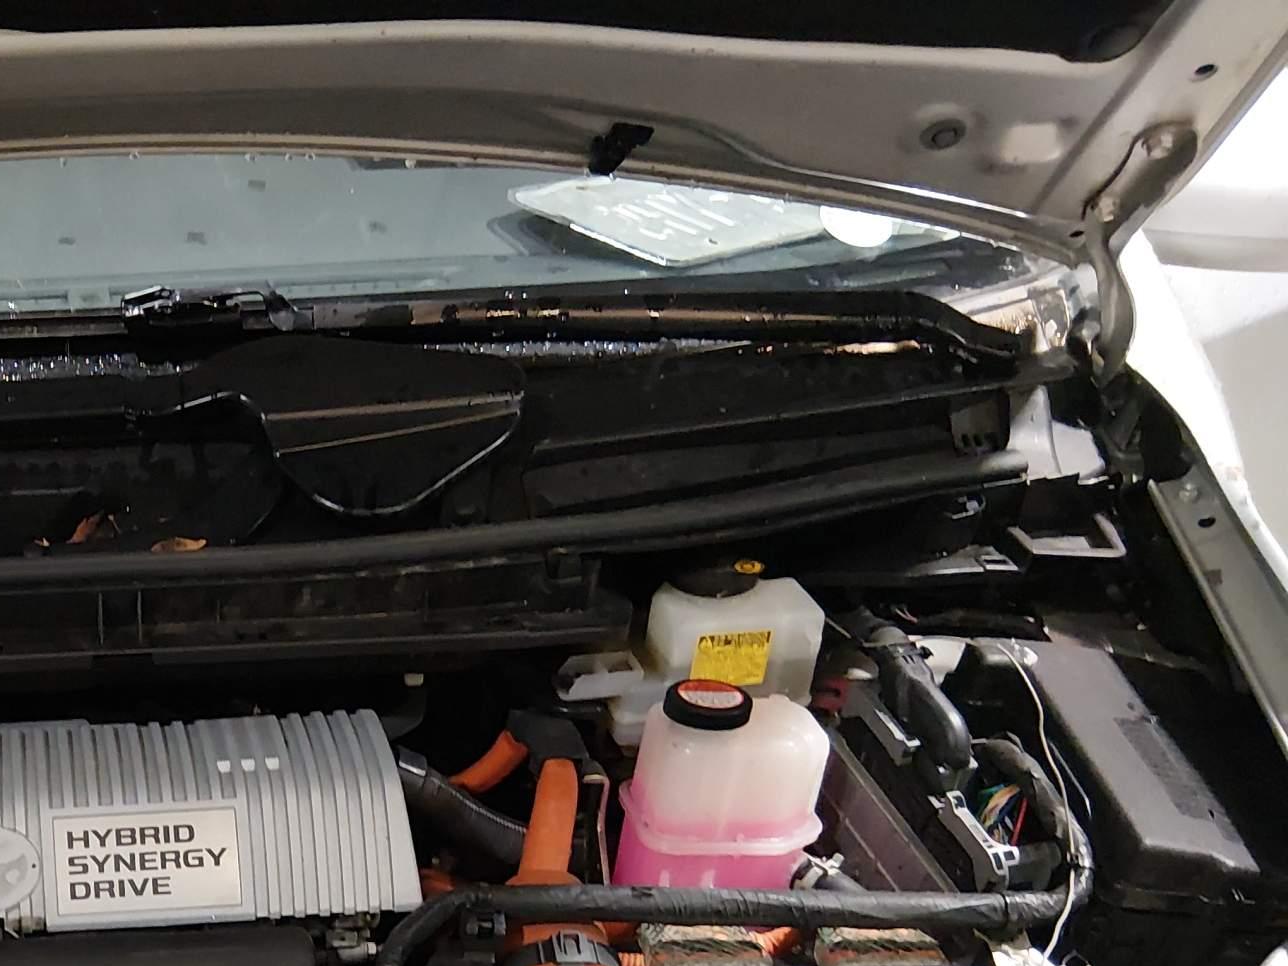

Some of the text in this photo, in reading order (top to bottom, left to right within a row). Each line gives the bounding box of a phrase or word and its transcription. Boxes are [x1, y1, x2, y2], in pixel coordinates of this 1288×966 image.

[66, 824, 195, 849] HYBRID
[68, 848, 227, 875] SYNERGY
[69, 876, 172, 900] DRIVE
